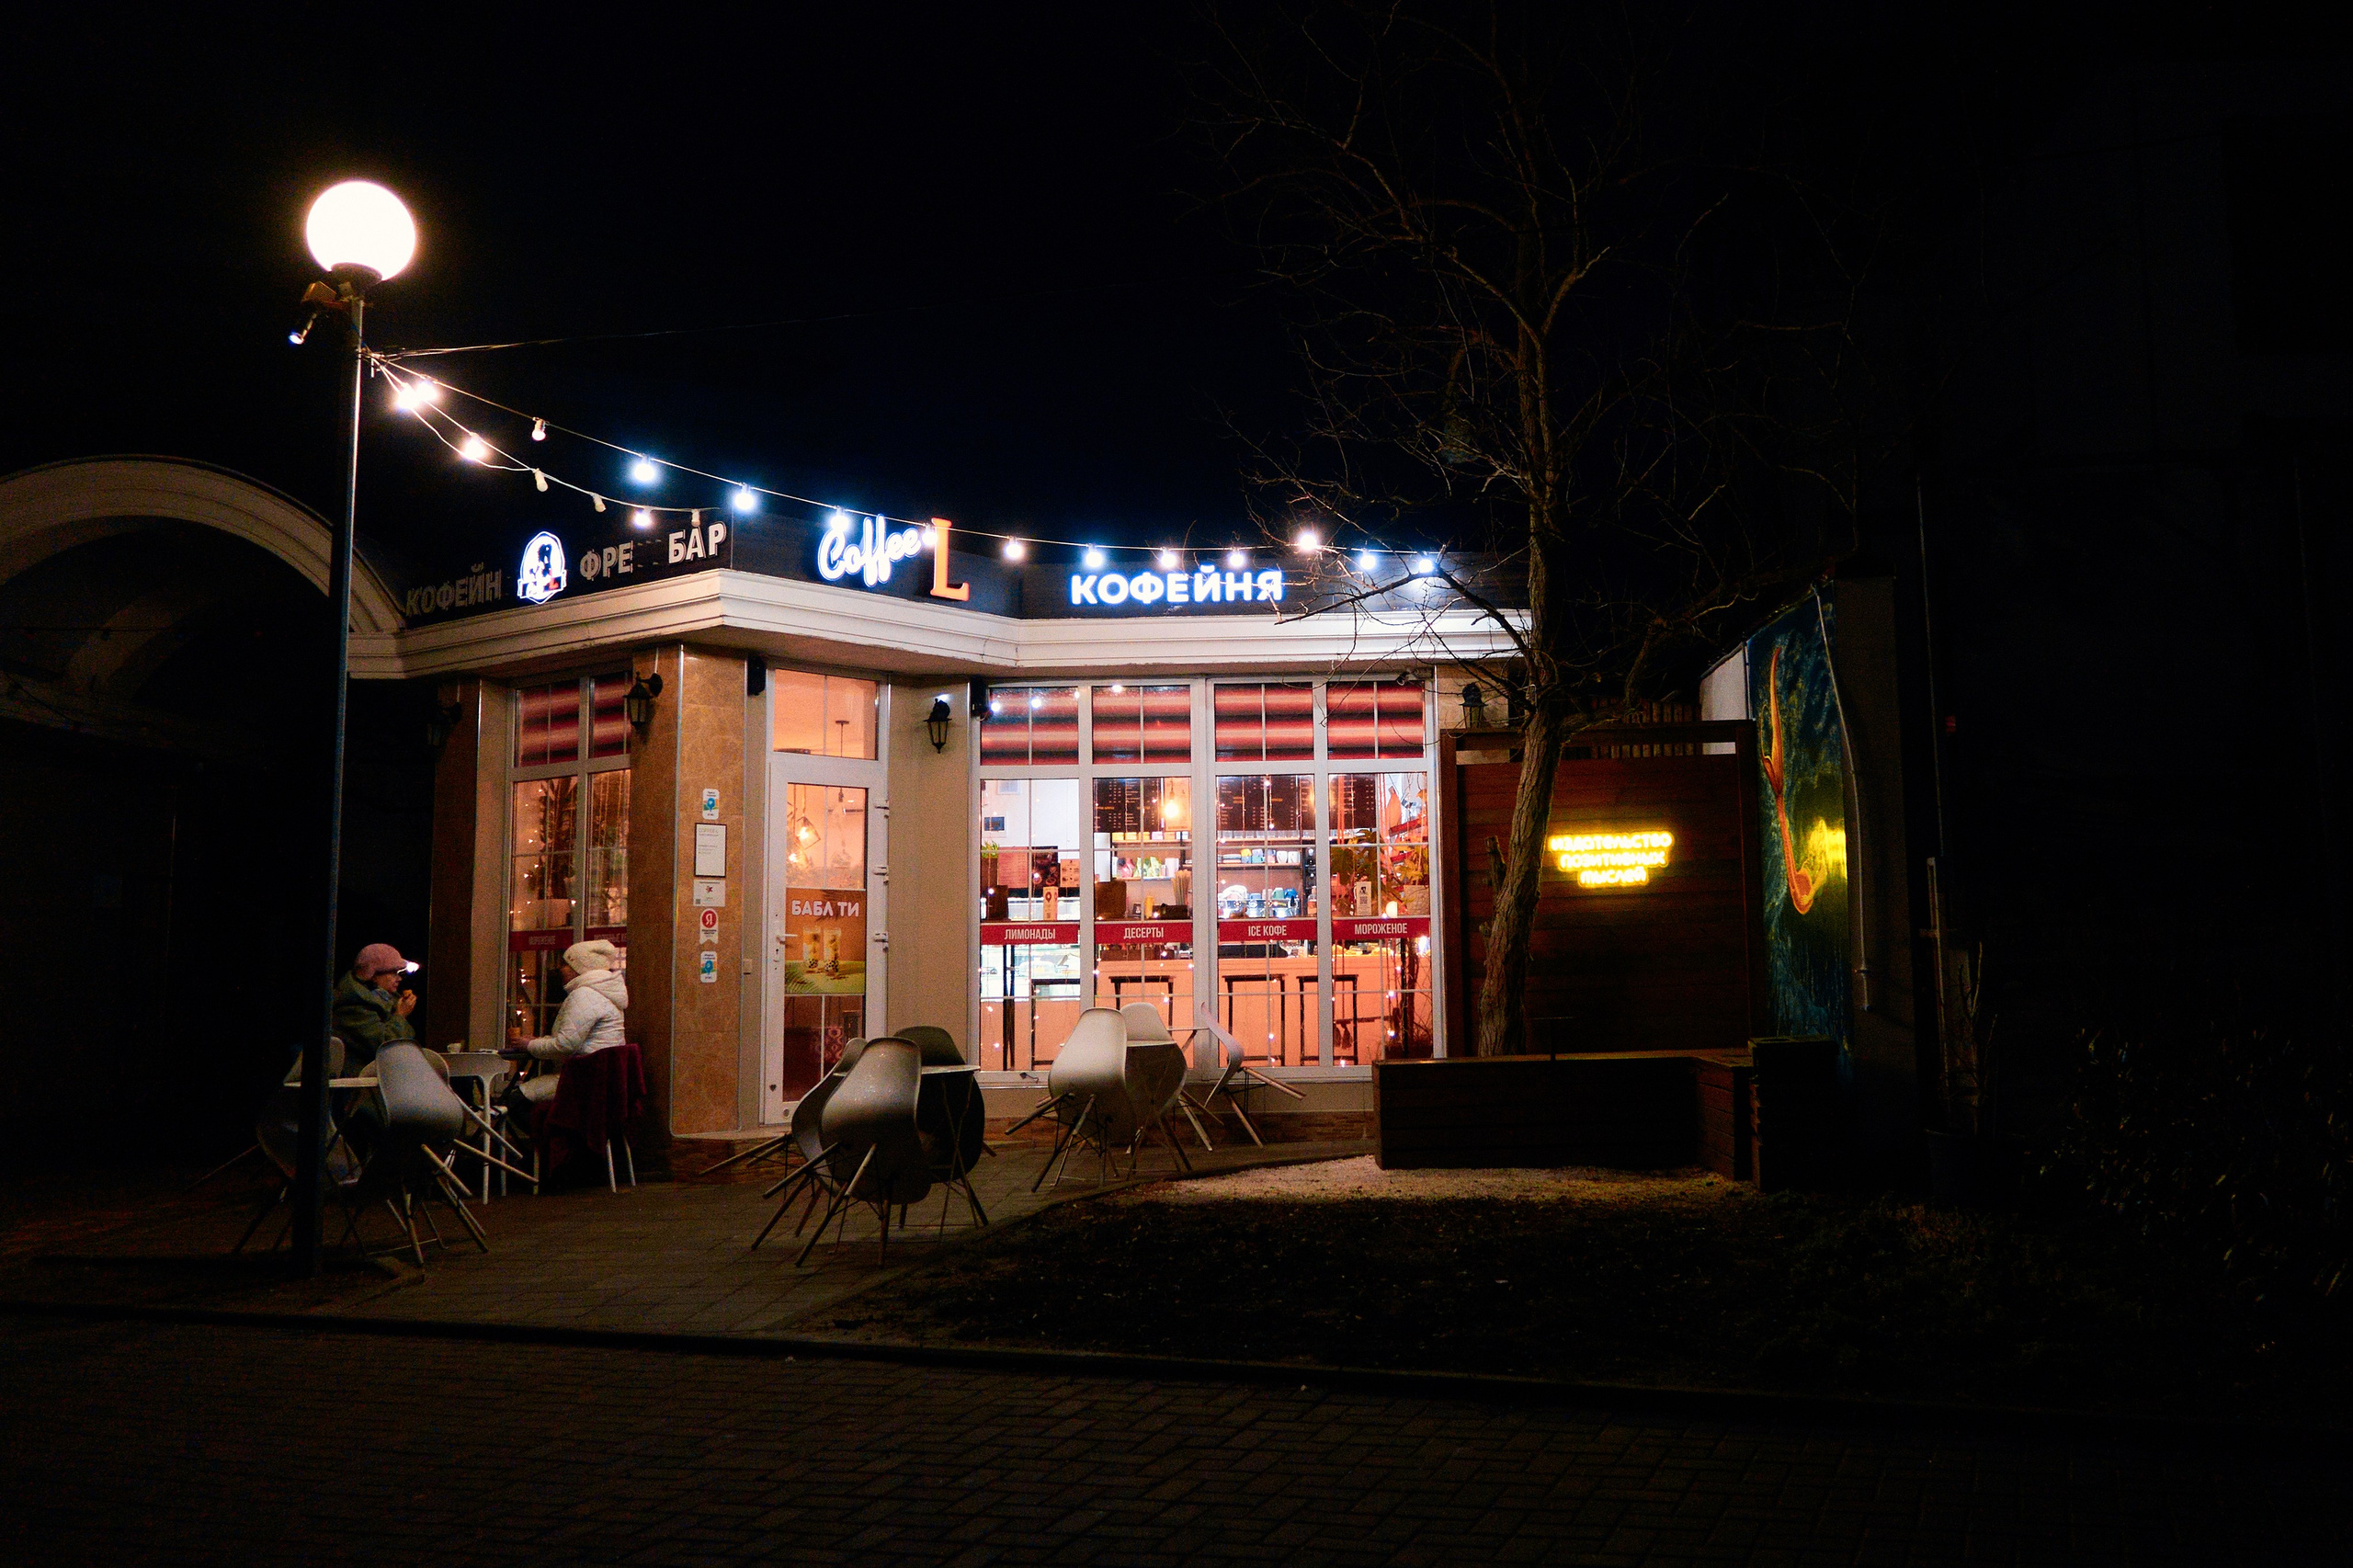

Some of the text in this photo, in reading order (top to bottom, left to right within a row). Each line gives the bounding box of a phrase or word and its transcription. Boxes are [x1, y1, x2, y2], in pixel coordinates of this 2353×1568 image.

[668, 520, 727, 564] БАР
[818, 514, 970, 602] Coffee L
[1071, 564, 1283, 605] КОФЕЙНЯ
[791, 900, 859, 917] БАБЛ ТИ
[1004, 928, 1056, 940] ЛИМОНАДЫ
[1123, 927, 1164, 939] ДЕСЕРТЫ
[1248, 925, 1287, 937] ICE КОФЕ
[1355, 923, 1407, 935] МОРОЖЕНОЕ
